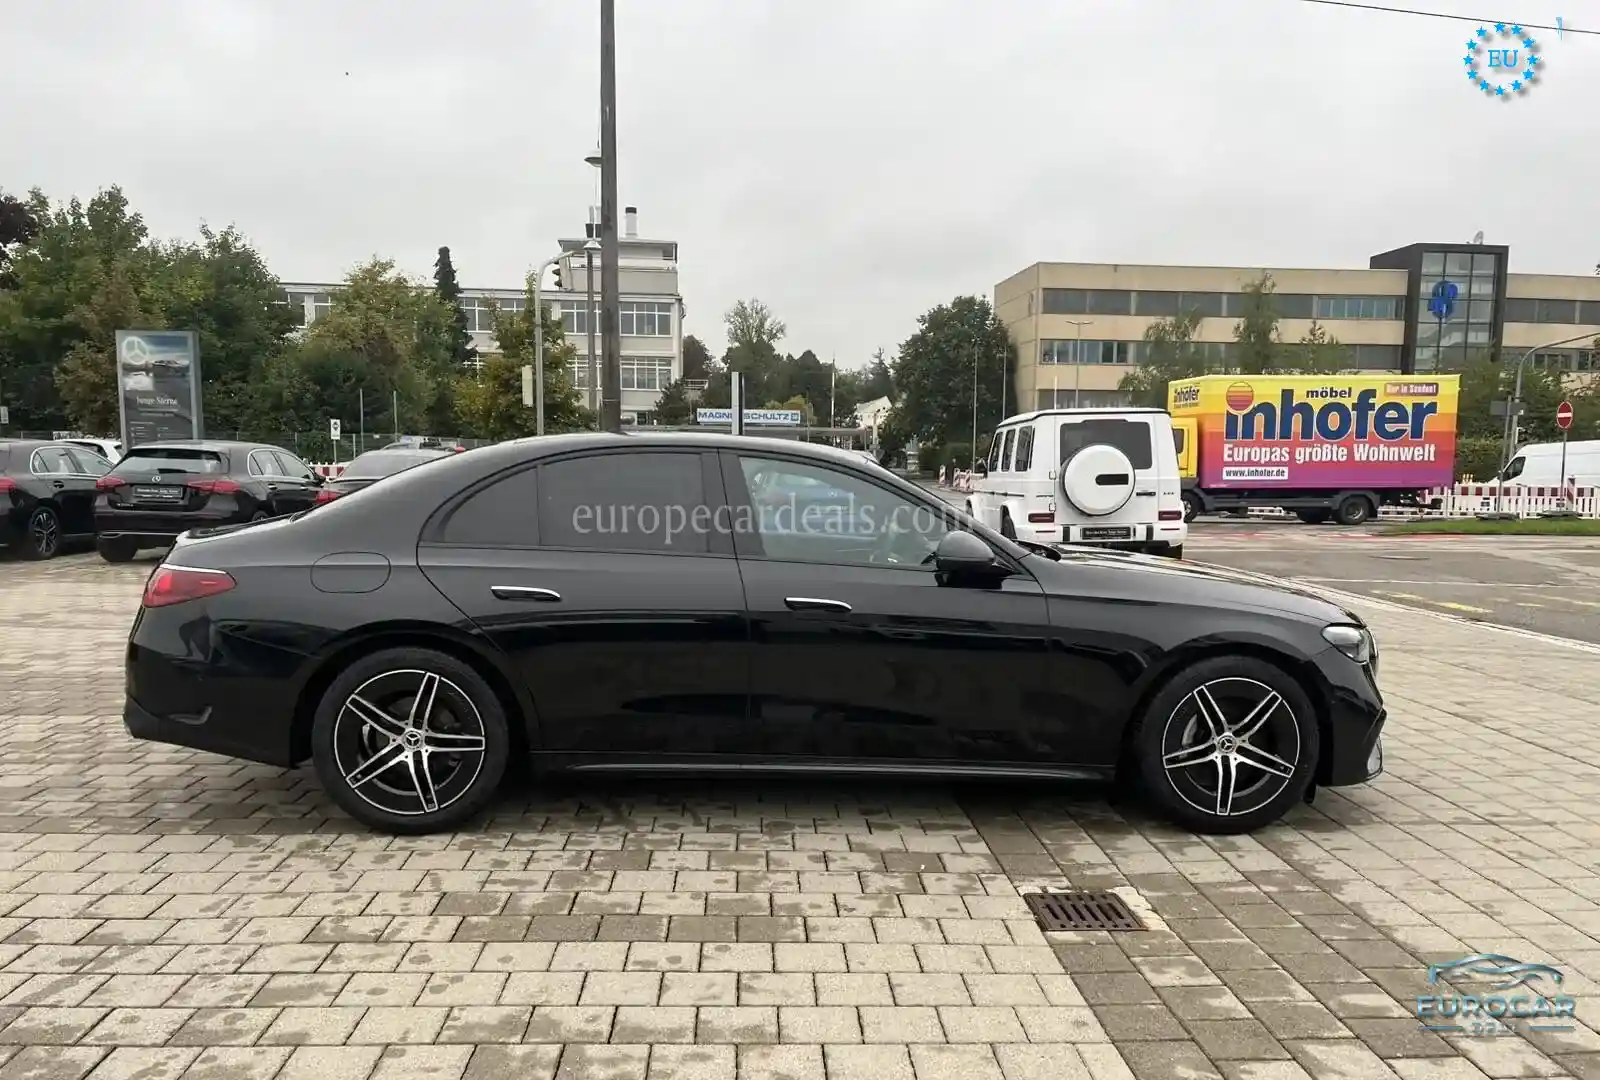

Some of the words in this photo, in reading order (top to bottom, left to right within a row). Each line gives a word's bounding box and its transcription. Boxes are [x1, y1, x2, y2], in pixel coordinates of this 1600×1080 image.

[1306, 386, 1352, 399] möbel
[1224, 382, 1438, 441] inhofer
[1223, 443, 1290, 463] Europas
[1295, 443, 1348, 464] größte
[1353, 443, 1436, 462] Wohnwelt
[1225, 468, 1286, 477] www.inhofer.de
